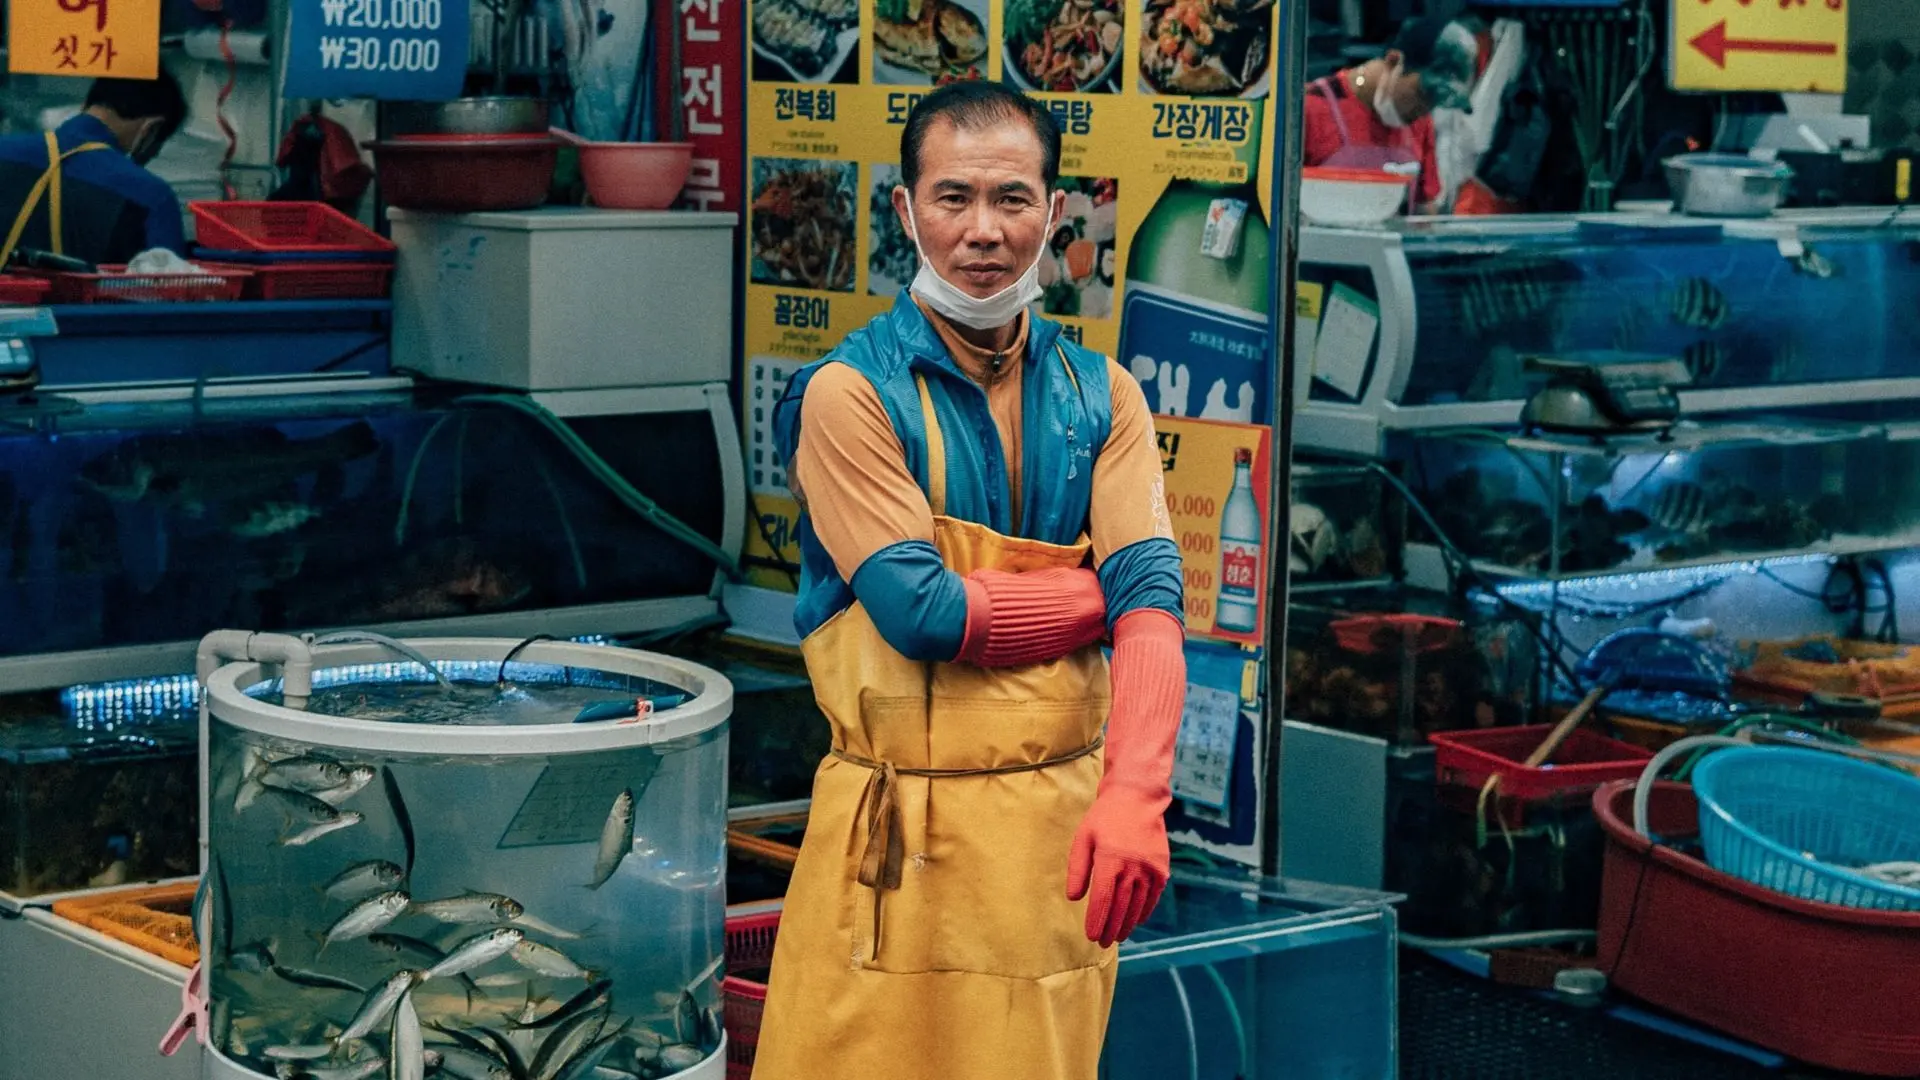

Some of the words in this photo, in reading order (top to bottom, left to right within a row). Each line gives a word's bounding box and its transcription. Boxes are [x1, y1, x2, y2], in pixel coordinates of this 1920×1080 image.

[52, 34, 118, 71] 싯가
[319, 36, 441, 72] ₩30,000
[775, 88, 836, 122] 전복회
[1042, 100, 1093, 135] 물탕
[1152, 103, 1250, 142] 간장게장
[774, 294, 829, 330] 꼼장어
